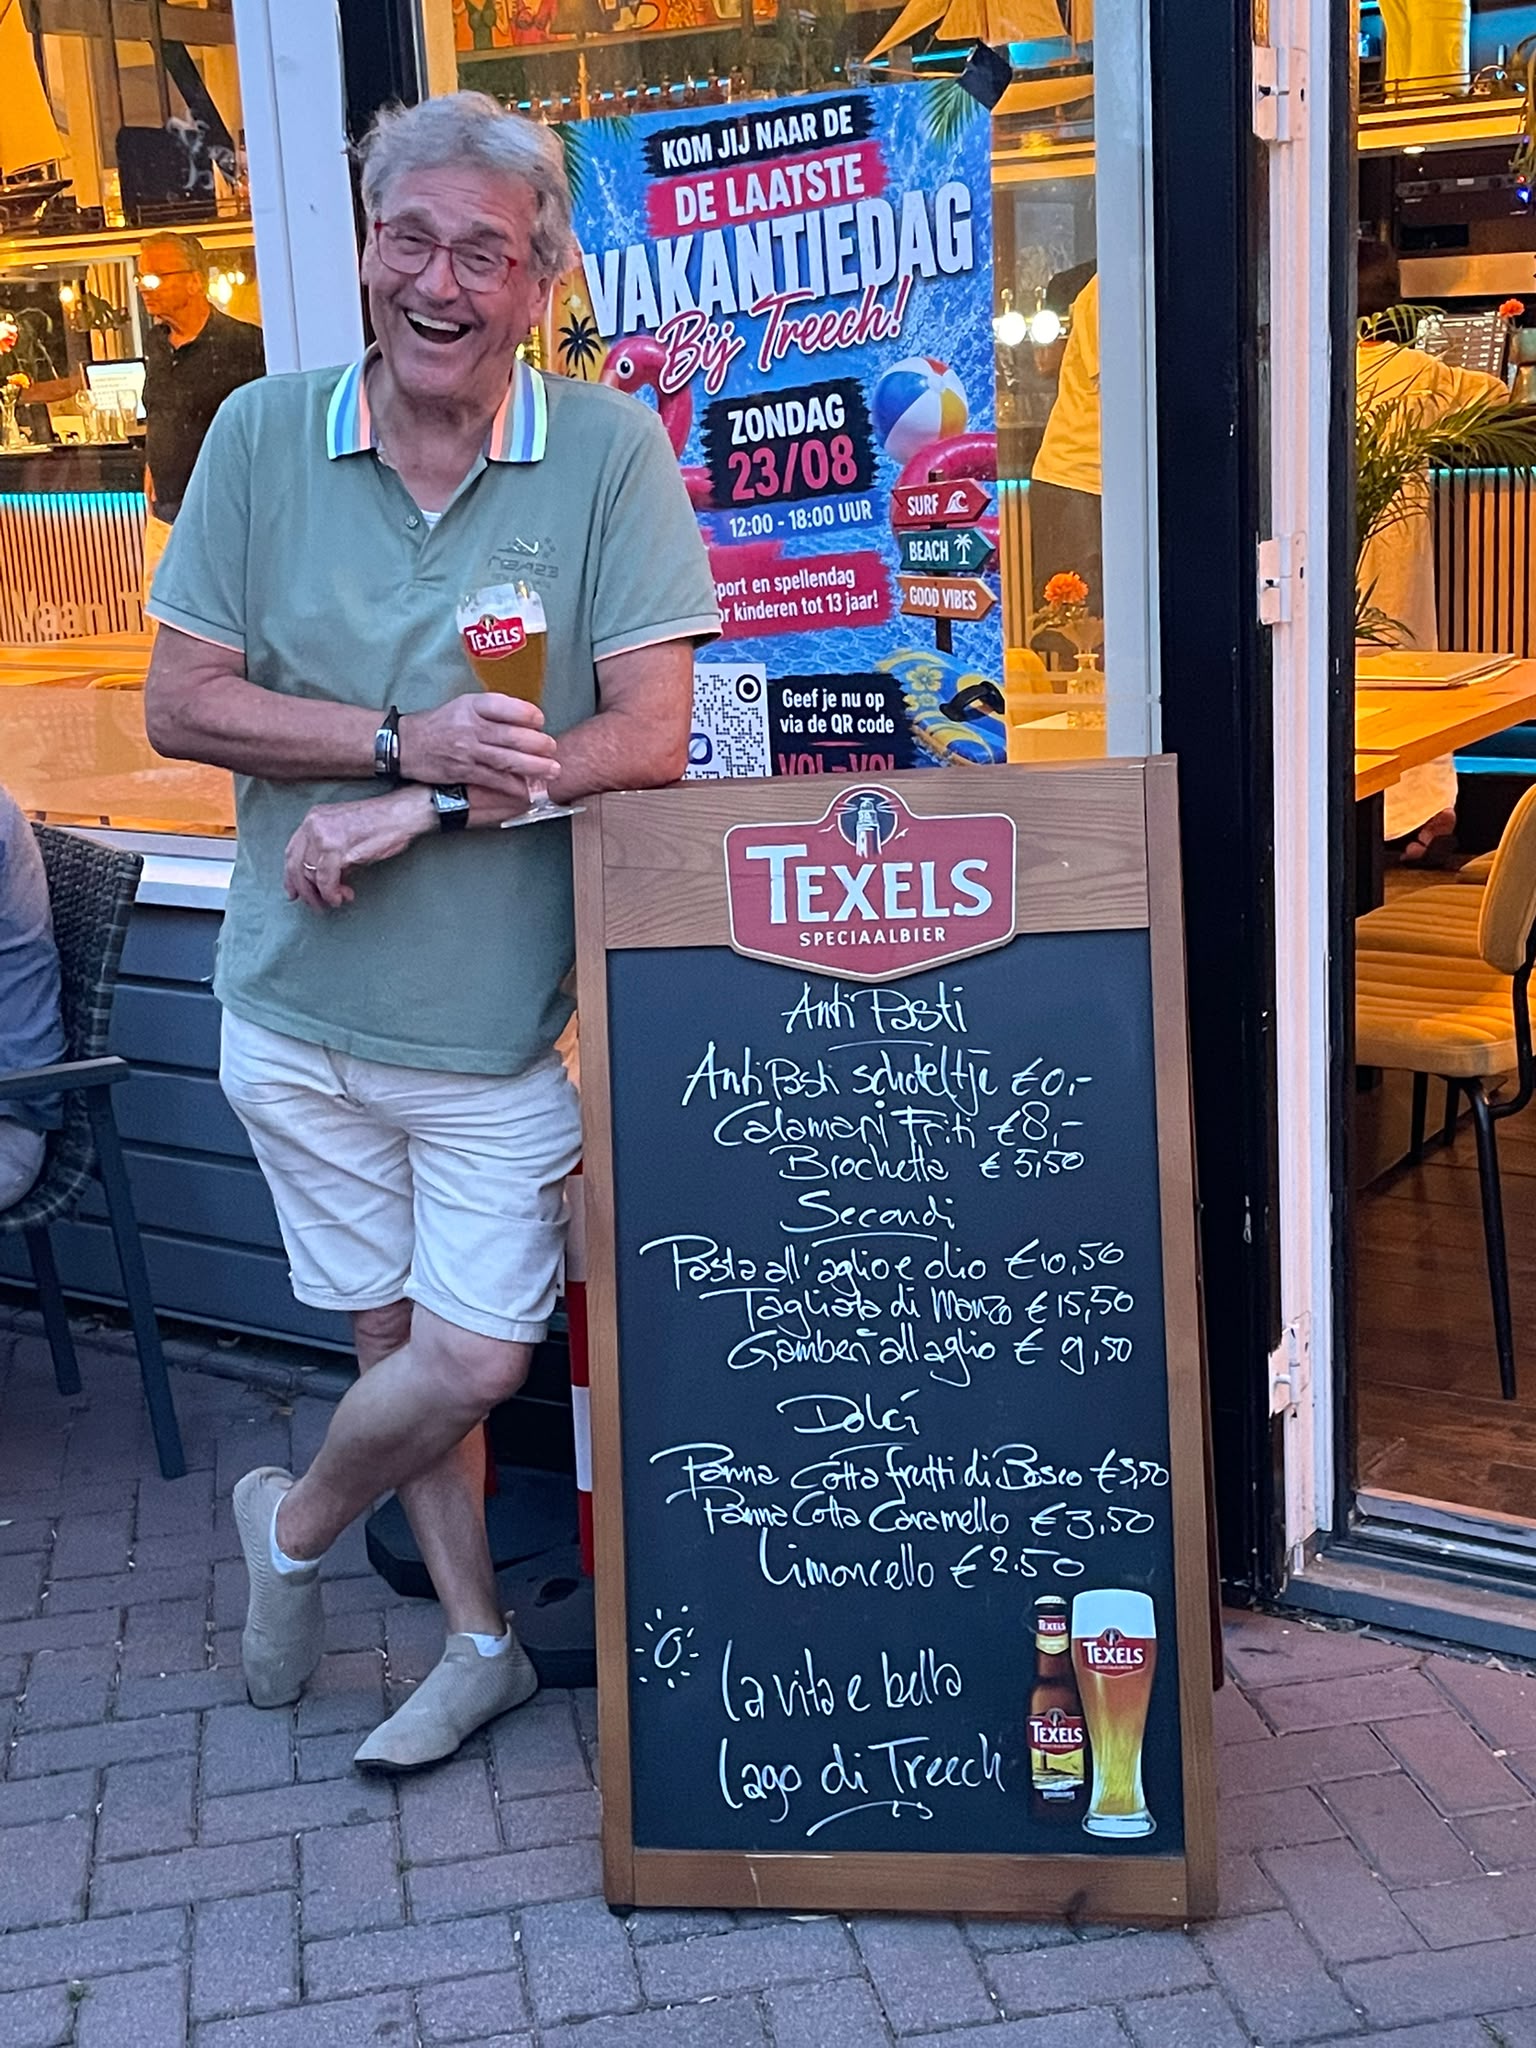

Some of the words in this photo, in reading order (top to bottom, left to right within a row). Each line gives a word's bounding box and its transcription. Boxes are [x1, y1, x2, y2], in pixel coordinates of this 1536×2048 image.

[662, 133, 713, 169] KOM
[717, 126, 750, 159] JIJ
[755, 113, 817, 151] NAAR
[823, 105, 854, 138] DE
[675, 181, 717, 226] DE
[725, 153, 865, 217] LAATSTE
[584, 182, 973, 338] VAKANTIEDAG
[658, 309, 741, 394] Bij
[750, 275, 913, 373] Treech!
[728, 394, 846, 445] ZONDAG
[728, 434, 858, 501] 23/08
[729, 514, 773, 538] 12:00
[788, 506, 834, 530] 18:00
[838, 500, 873, 523] UUR
[907, 494, 939, 516] SURF
[909, 541, 949, 562] BEACH
[752, 578, 770, 594] en
[774, 566, 855, 595] spellendag
[909, 586, 940, 608] GOOD
[942, 589, 977, 611] VIBES
[734, 600, 798, 622] kinderen
[801, 596, 824, 615] tot
[826, 593, 843, 613] 13
[845, 589, 879, 616] jaar!
[782, 688, 818, 708] Geef
[822, 688, 837, 713] je
[841, 692, 861, 708] nu
[865, 692, 885, 713] op
[780, 713, 804, 734] via
[807, 713, 827, 734] de
[831, 713, 853, 735] QR
[857, 713, 895, 734] code
[799, 927, 946, 947] SPECIAALBIER
[639, 1234, 757, 1292] Pasta
[924, 1241, 986, 1280] olio
[890, 1283, 921, 1318] di
[649, 1442, 780, 1501] Panna
[964, 1448, 991, 1488] di
[665, 1485, 788, 1535] Panna
[820, 1743, 869, 1795] di
[867, 1732, 1006, 1795] Treech
